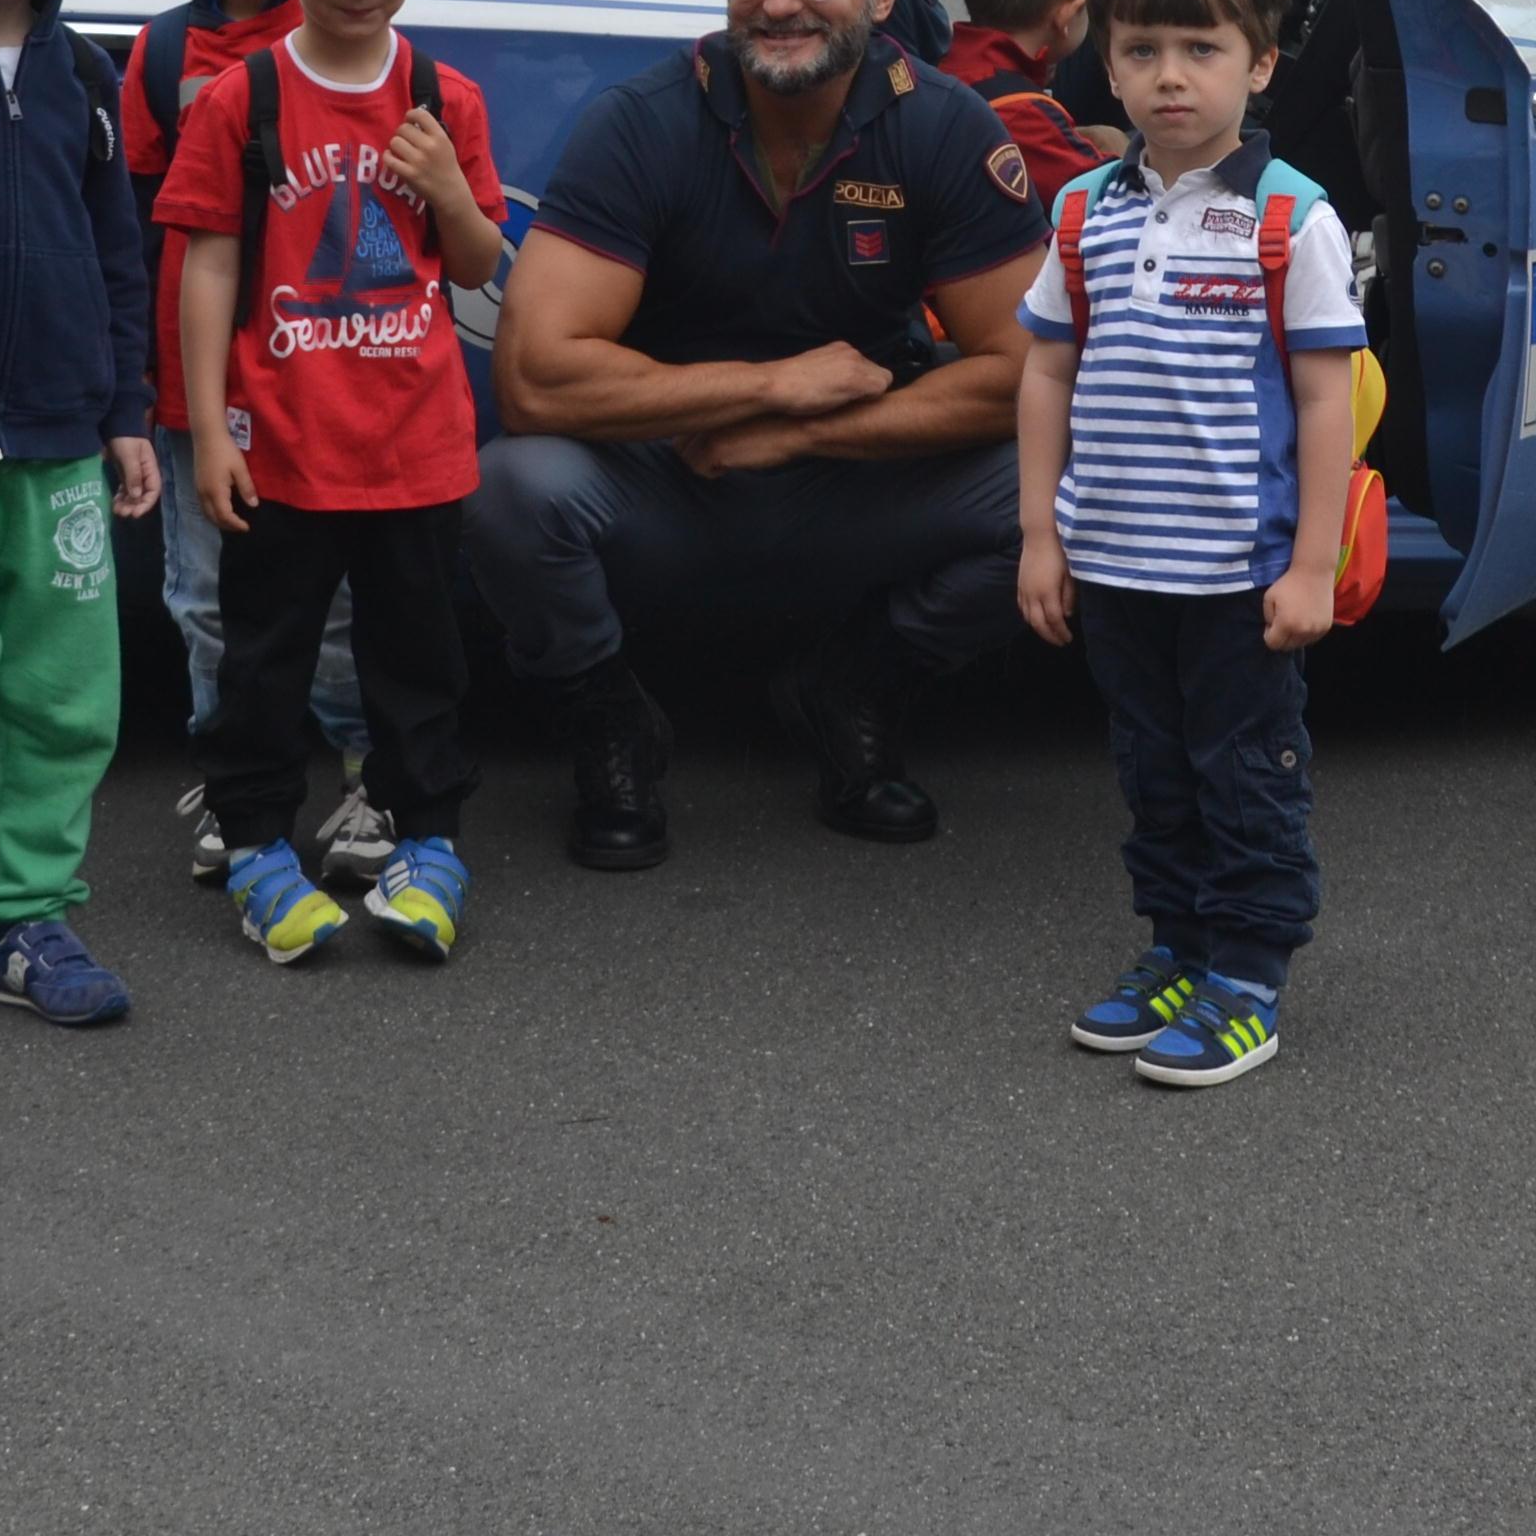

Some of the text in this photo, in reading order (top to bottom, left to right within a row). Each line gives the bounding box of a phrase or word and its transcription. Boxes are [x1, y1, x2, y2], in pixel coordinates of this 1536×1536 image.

[835, 184, 901, 205] POLIZIA
[269, 284, 433, 359] Seaview
[359, 346, 392, 358] OCEAN
[51, 570, 86, 590] NEW
